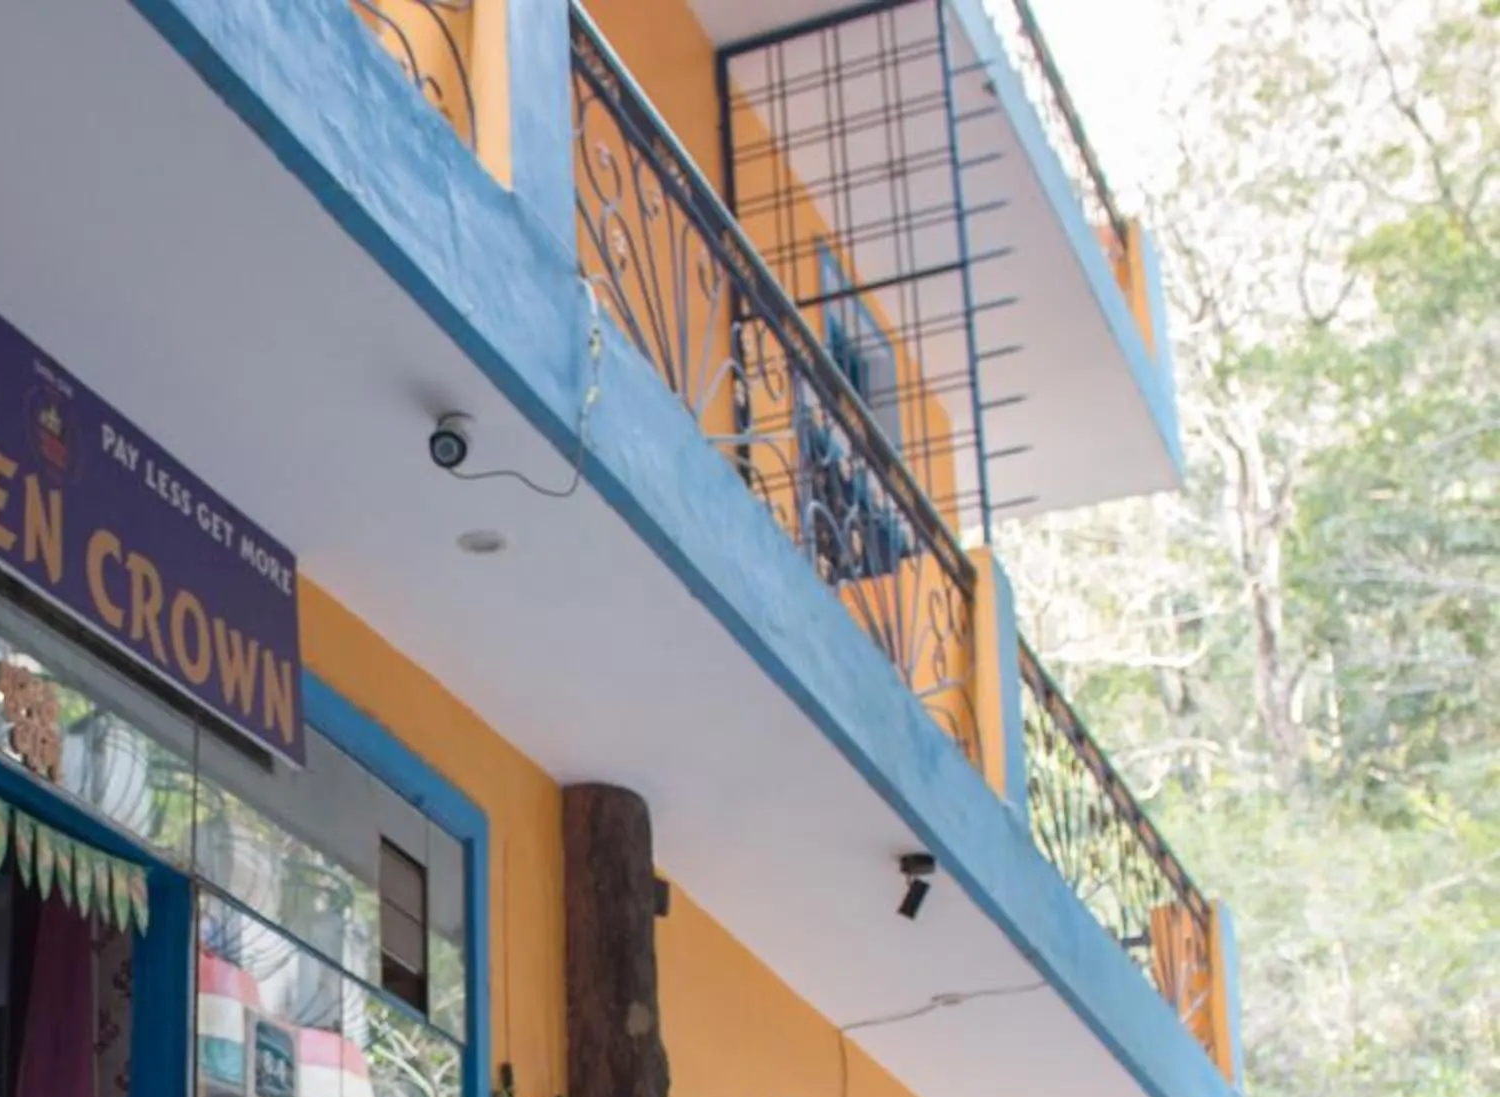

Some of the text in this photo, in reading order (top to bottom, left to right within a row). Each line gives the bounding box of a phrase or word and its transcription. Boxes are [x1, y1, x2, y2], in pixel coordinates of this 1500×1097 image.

[101, 423, 293, 597] PAY LESS GET MORE
[86, 528, 296, 745] CROWN
